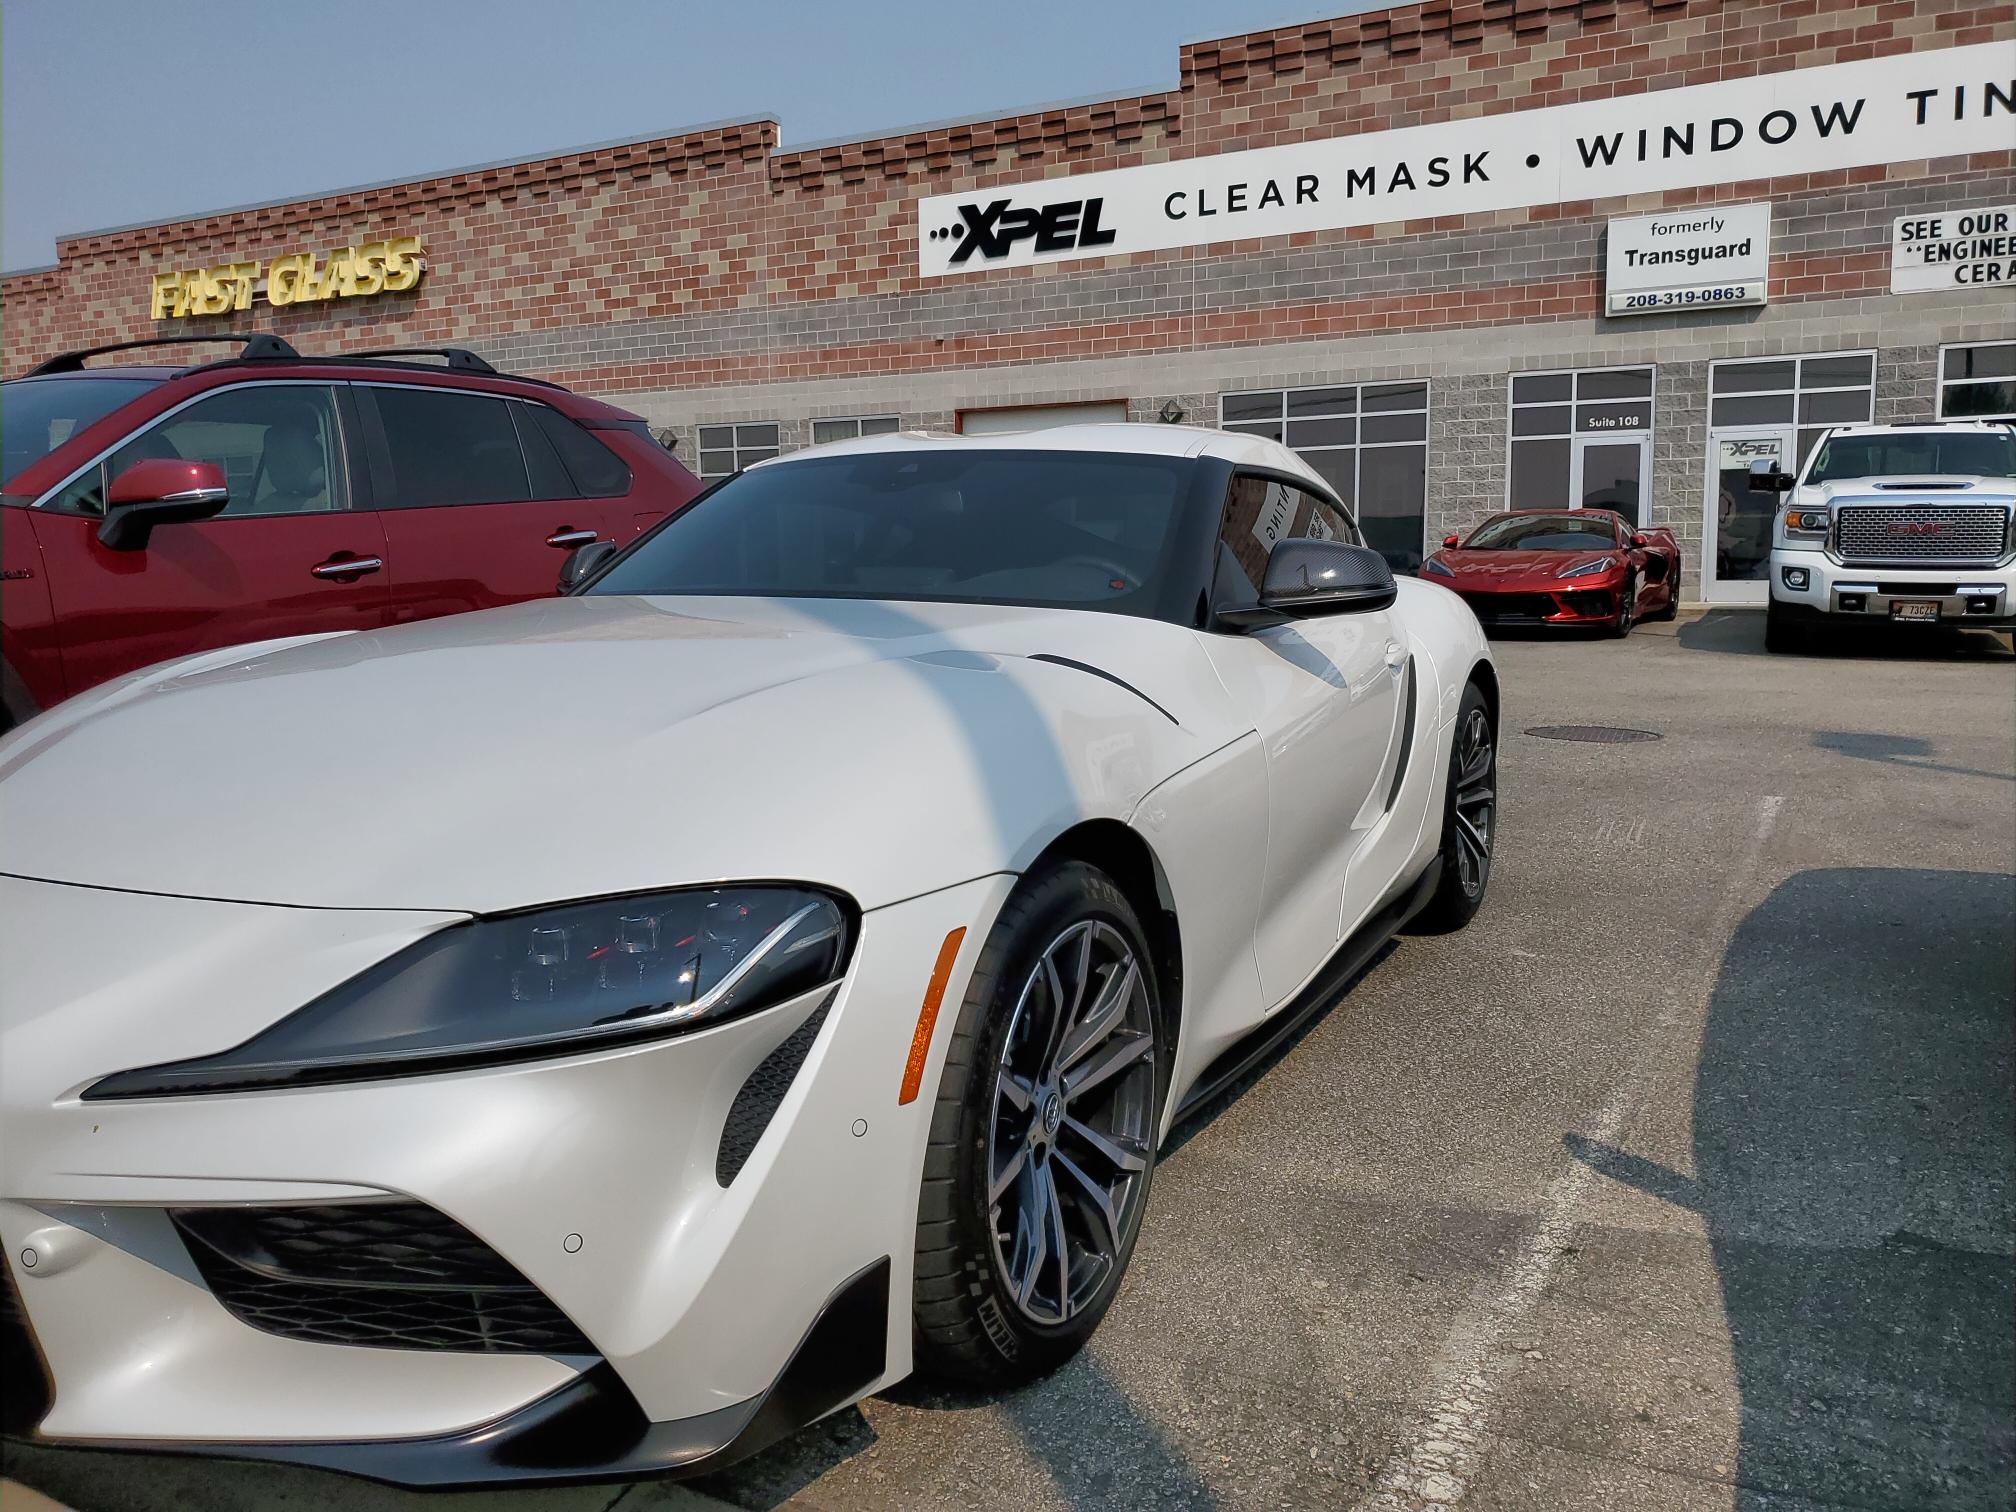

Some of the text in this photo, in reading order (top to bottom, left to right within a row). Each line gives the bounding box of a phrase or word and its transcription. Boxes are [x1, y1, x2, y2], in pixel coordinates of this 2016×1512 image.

[1165, 79, 2016, 220] CLEAR MASK WINDOW TIN
[949, 197, 1116, 262] XPEL
[1651, 216, 1724, 236] formerly
[1901, 213, 2008, 241] SEE OUR
[1625, 238, 1751, 266] Transguard
[151, 237, 421, 320] FAST GLASS
[1626, 286, 1746, 308] 208-319-0863
[1589, 416, 1639, 427] Suite 108
[1730, 443, 1779, 456] XPEL
[1887, 522, 1955, 537] GMC
